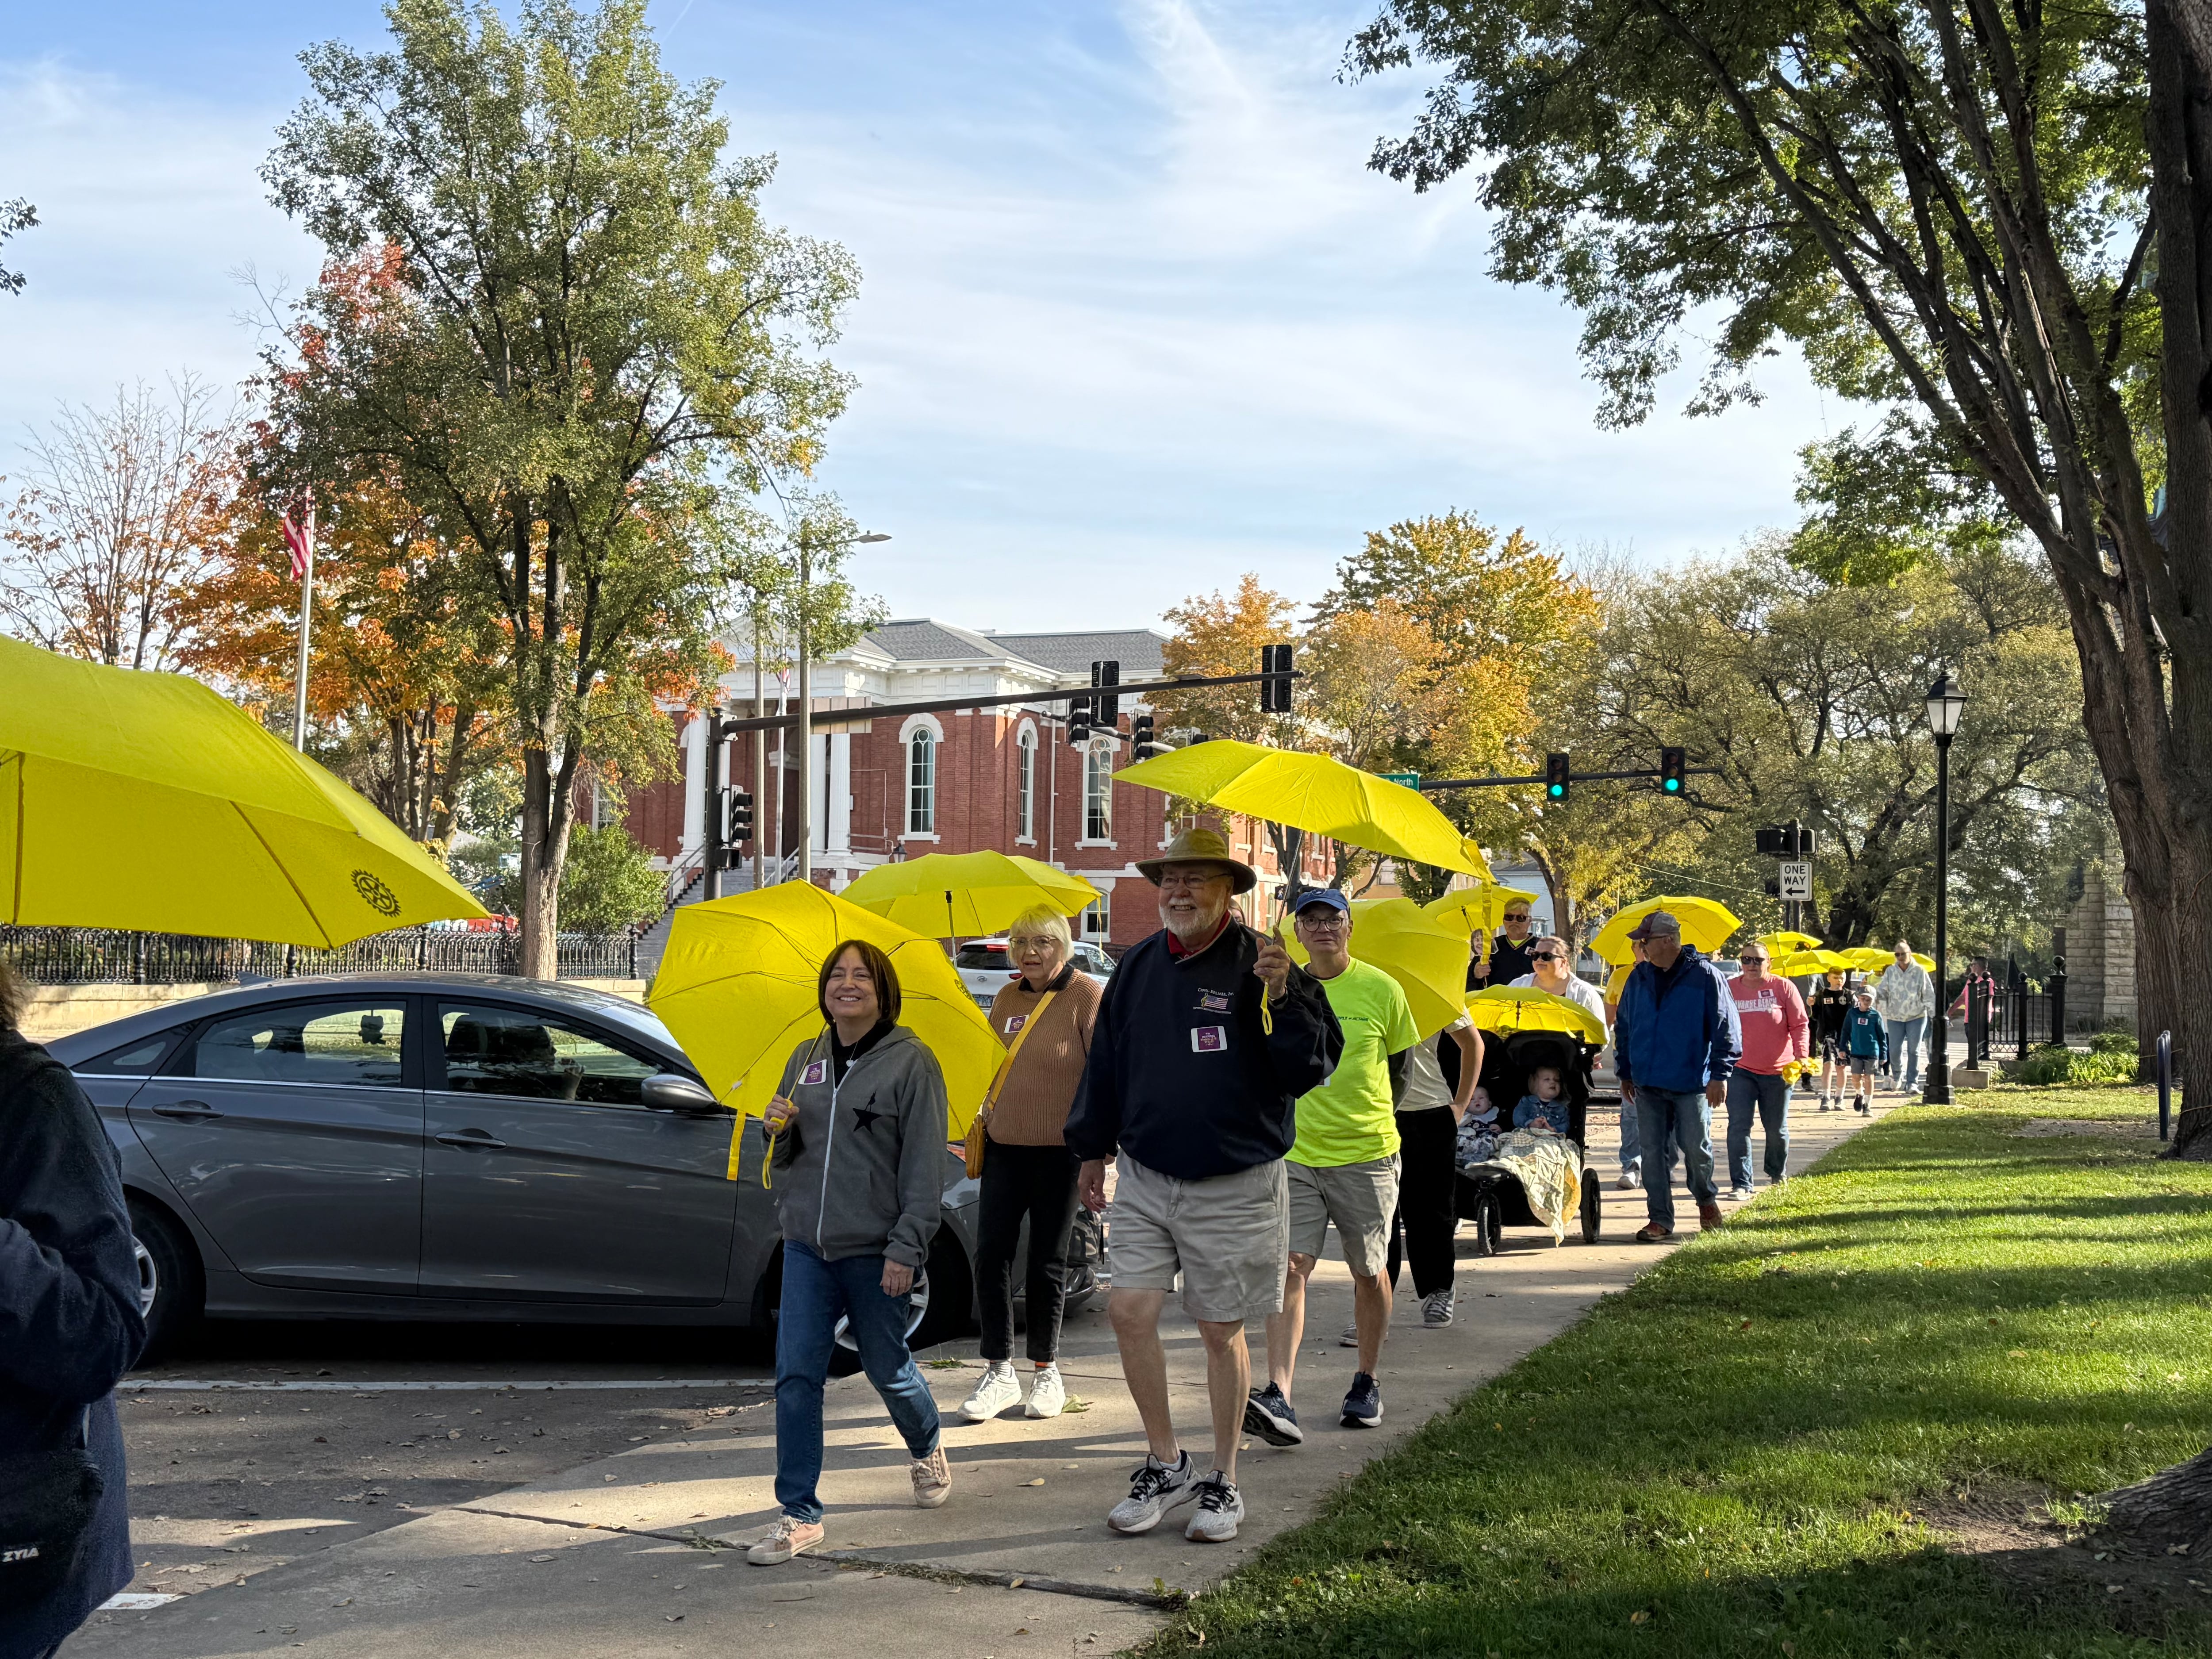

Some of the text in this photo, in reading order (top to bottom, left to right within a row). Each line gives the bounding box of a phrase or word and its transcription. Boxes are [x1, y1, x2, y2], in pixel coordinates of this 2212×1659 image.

[1394, 778, 1413, 786] North
[1784, 865, 1806, 874] ONE
[1784, 876, 1806, 885] WAY
[2, 1547, 39, 1562] ZYIA
